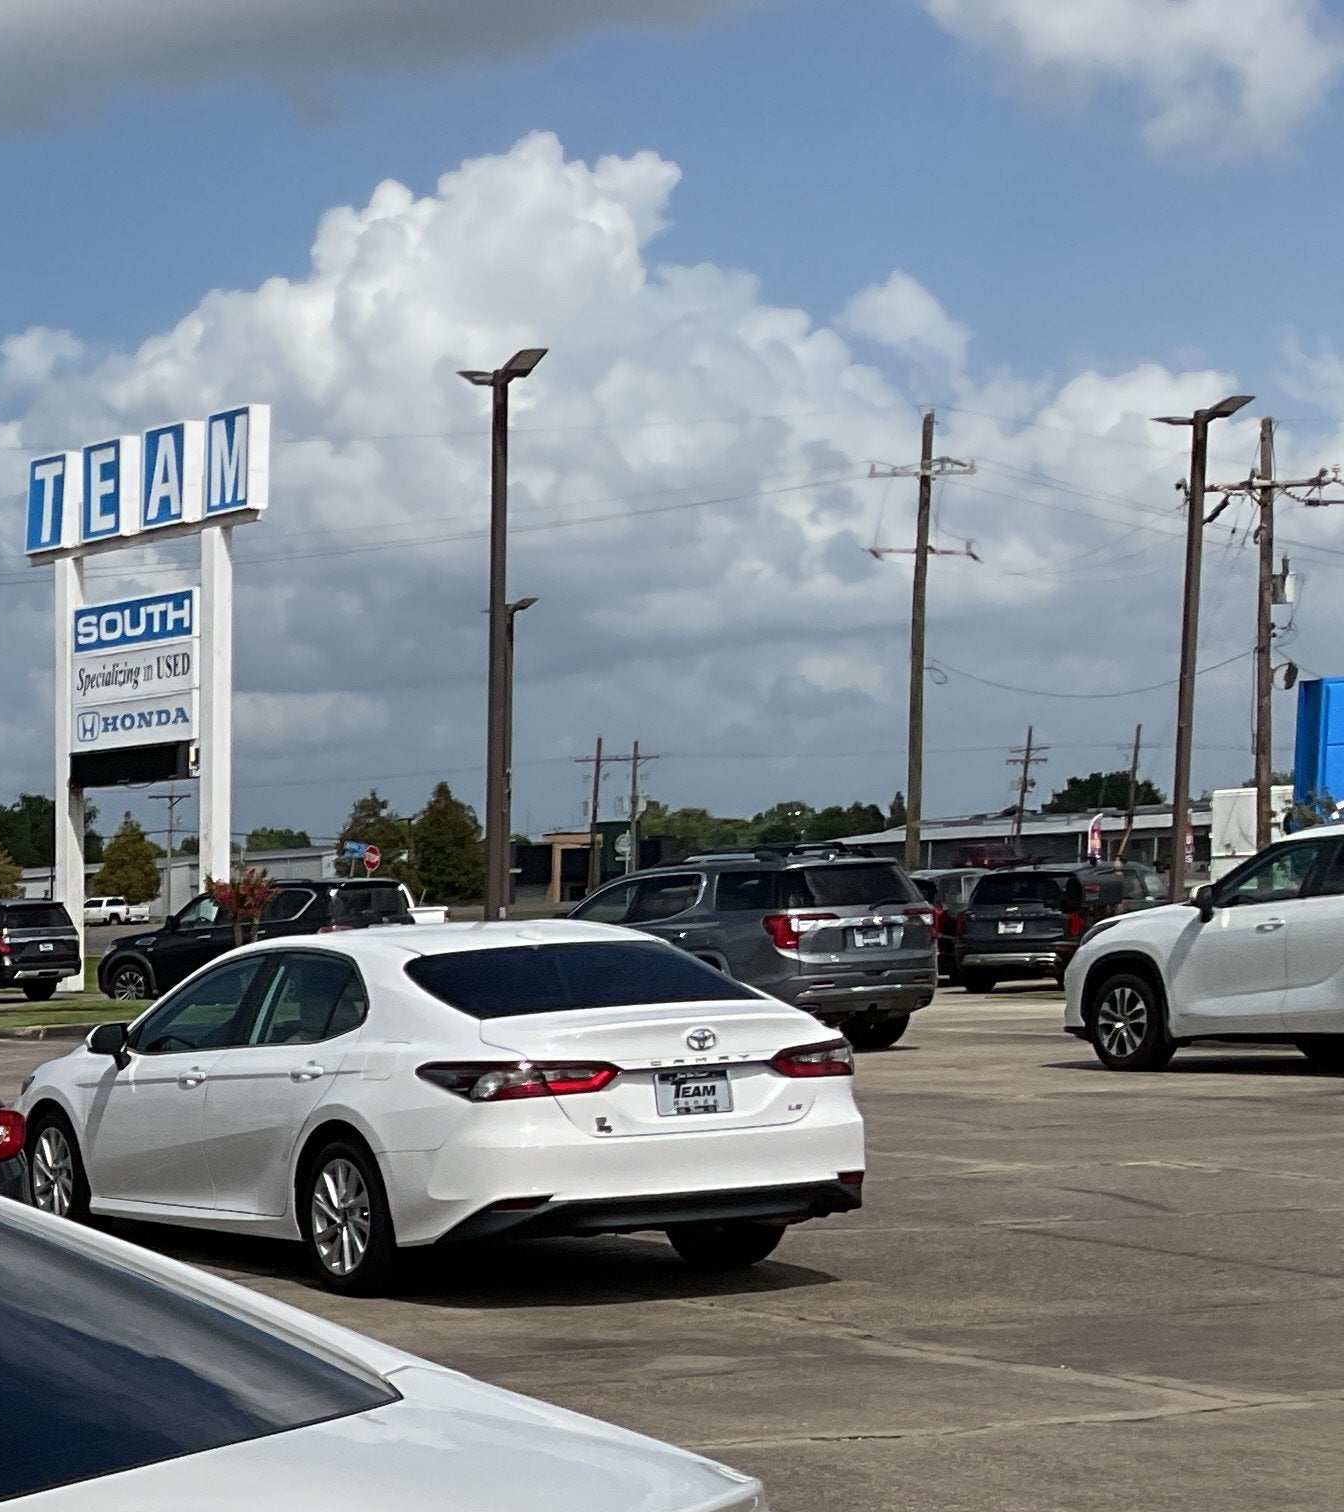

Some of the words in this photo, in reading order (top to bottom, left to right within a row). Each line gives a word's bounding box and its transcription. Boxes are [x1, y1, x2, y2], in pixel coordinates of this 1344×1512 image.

[34, 414, 248, 543] TEAM
[77, 599, 190, 644] SOUTH
[76, 661, 140, 696] Specializing
[143, 659, 153, 681] in
[157, 652, 190, 680] USED
[102, 707, 190, 733] HONDA
[651, 1054, 750, 1066] CAMRY
[671, 1080, 717, 1099] TEAM
